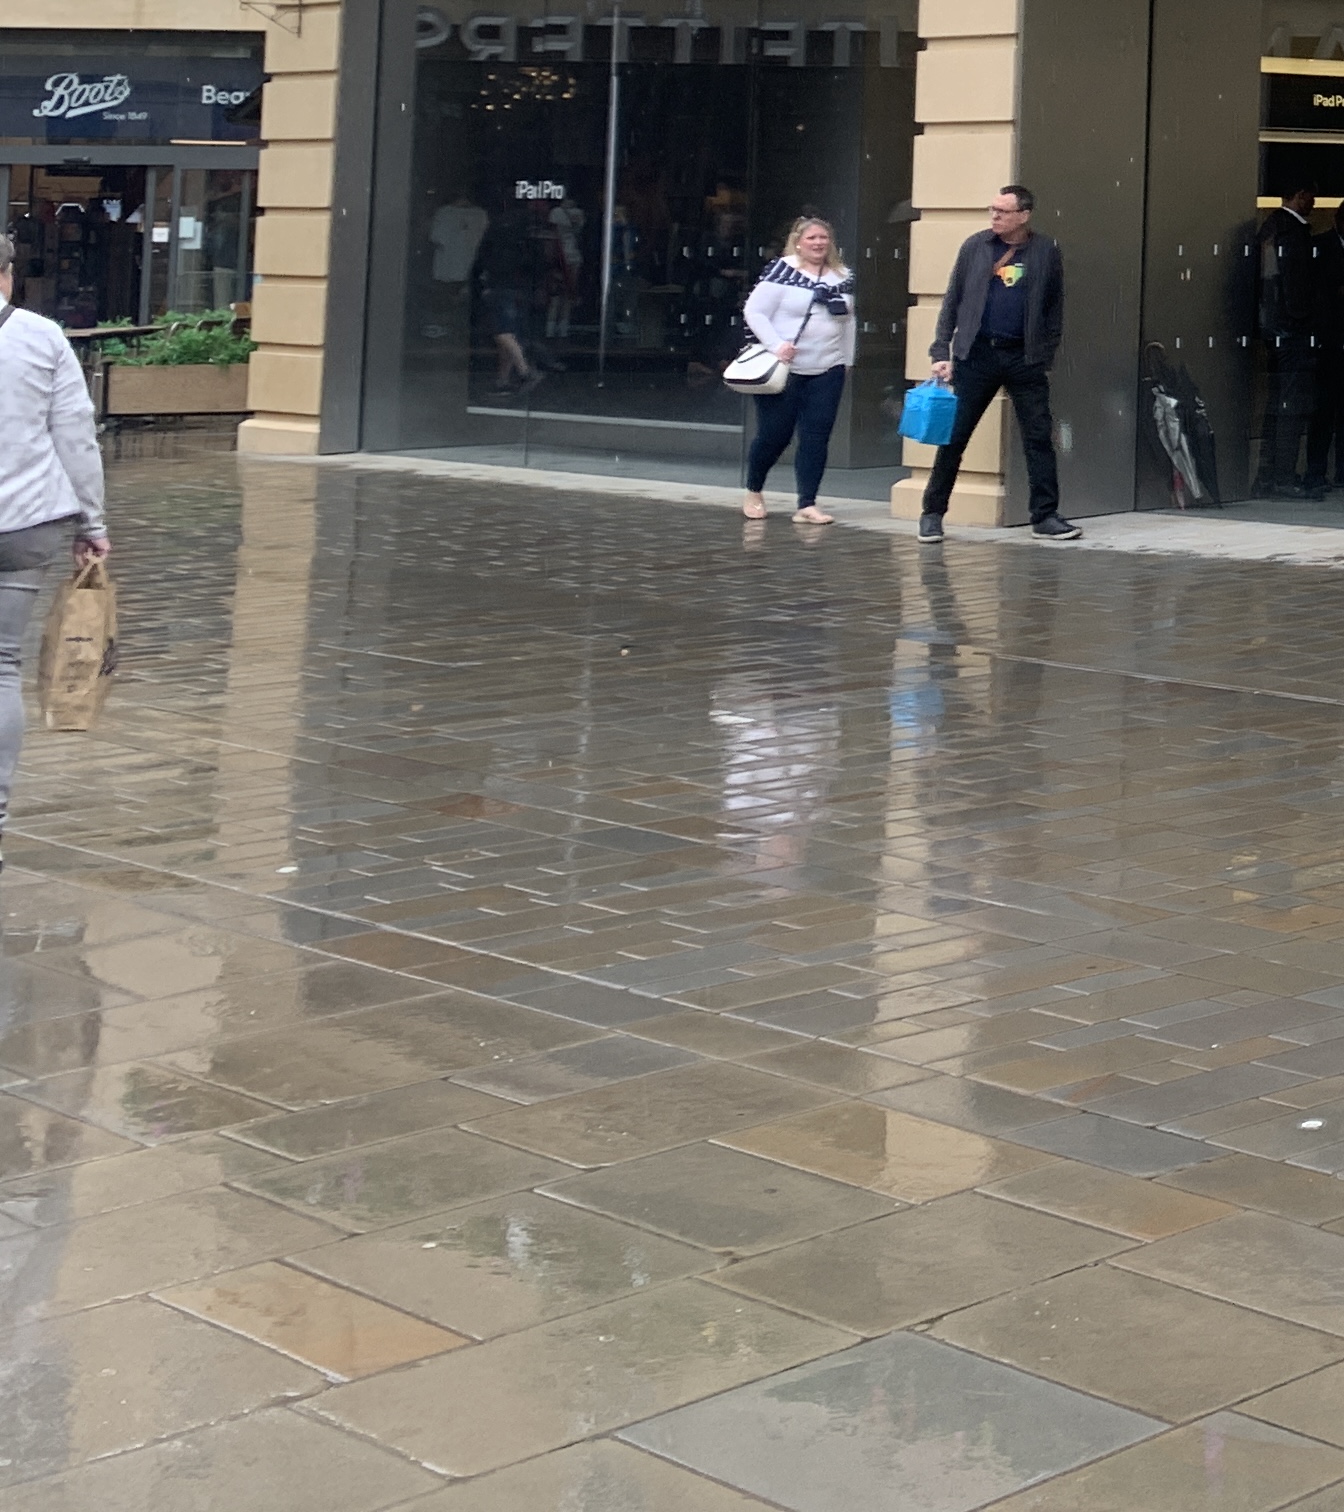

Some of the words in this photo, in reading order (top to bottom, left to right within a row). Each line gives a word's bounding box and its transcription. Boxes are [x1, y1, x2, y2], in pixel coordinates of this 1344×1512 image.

[32, 71, 131, 119] Boots
[1313, 94, 1335, 107] iPad
[543, 180, 565, 200] Pro
